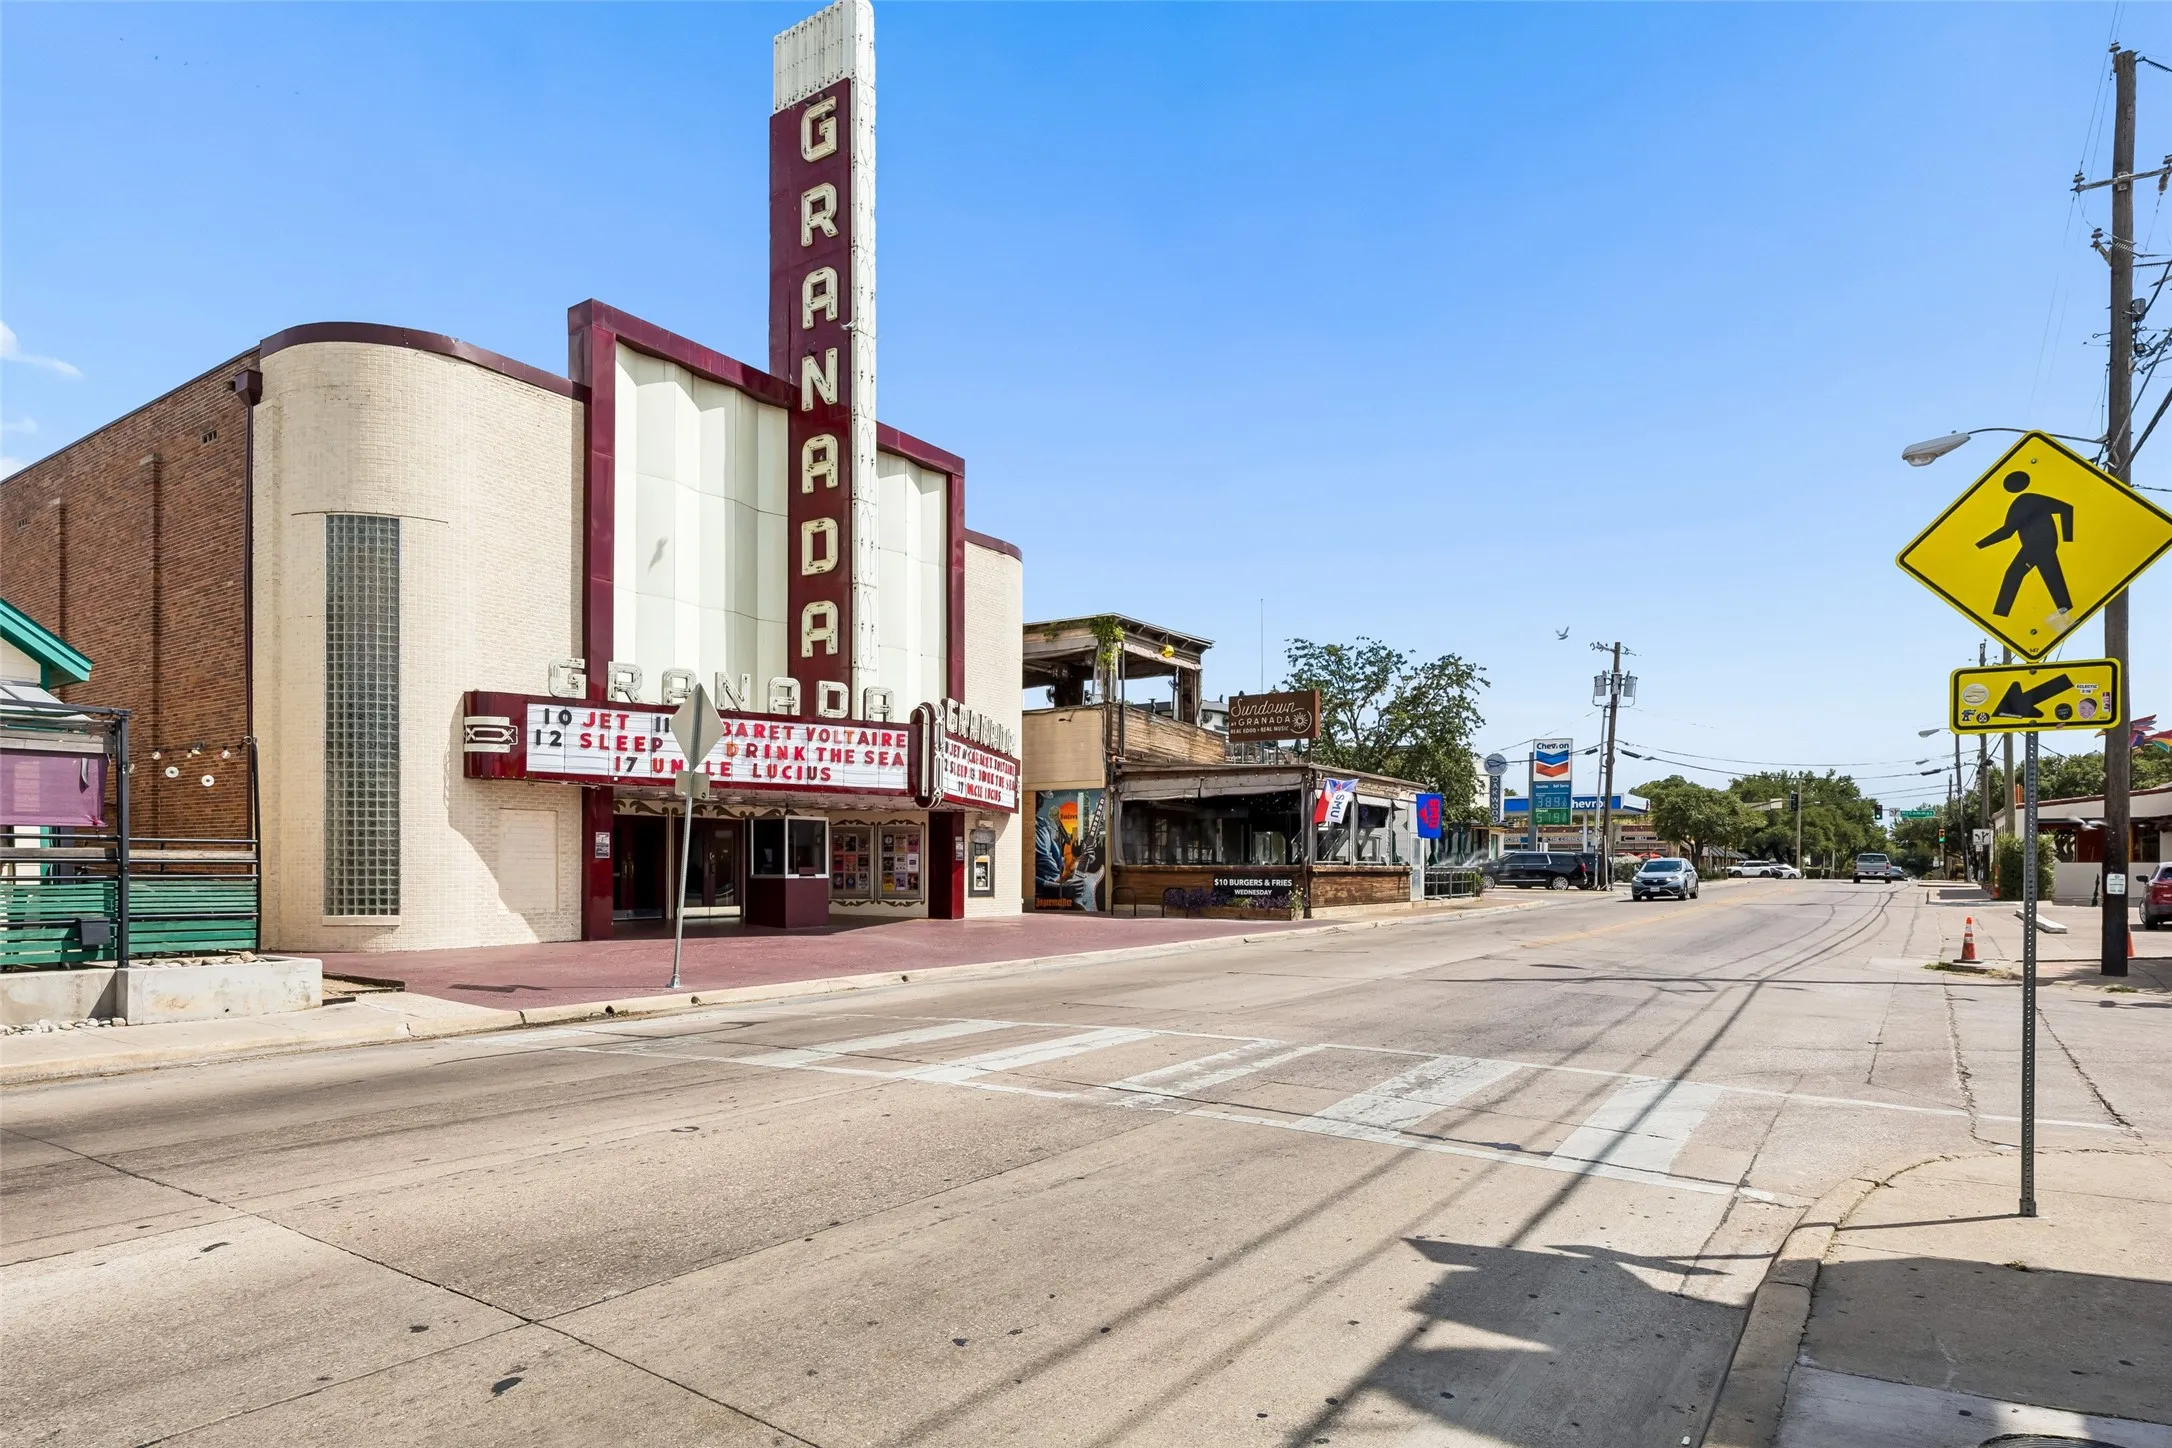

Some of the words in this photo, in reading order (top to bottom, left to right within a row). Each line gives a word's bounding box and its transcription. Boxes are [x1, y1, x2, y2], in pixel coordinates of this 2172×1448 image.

[801, 95, 839, 658] GRANADA
[548, 657, 895, 724] GRANADA
[1231, 698, 1304, 718] Sundown
[1238, 715, 1291, 727] GRANADA
[543, 708, 573, 726] 10
[582, 711, 630, 731] JET
[806, 726, 906, 749] VOLTAIRE
[535, 729, 562, 747] 12
[580, 732, 664, 753] SLEEP
[725, 741, 806, 762] DRINK
[815, 747, 856, 765] THE
[864, 750, 905, 767] SEA
[614, 755, 639, 773] 17
[652, 757, 732, 778] UNLE
[752, 762, 832, 782] LUCIUS
[1330, 794, 1345, 819] SMU
[1491, 776, 1499, 823] OAKWOOD
[1214, 878, 1229, 887] $10
[1229, 878, 1264, 887] BURGERS
[1264, 879, 1271, 887] &
[1271, 879, 1293, 887] FRIES
